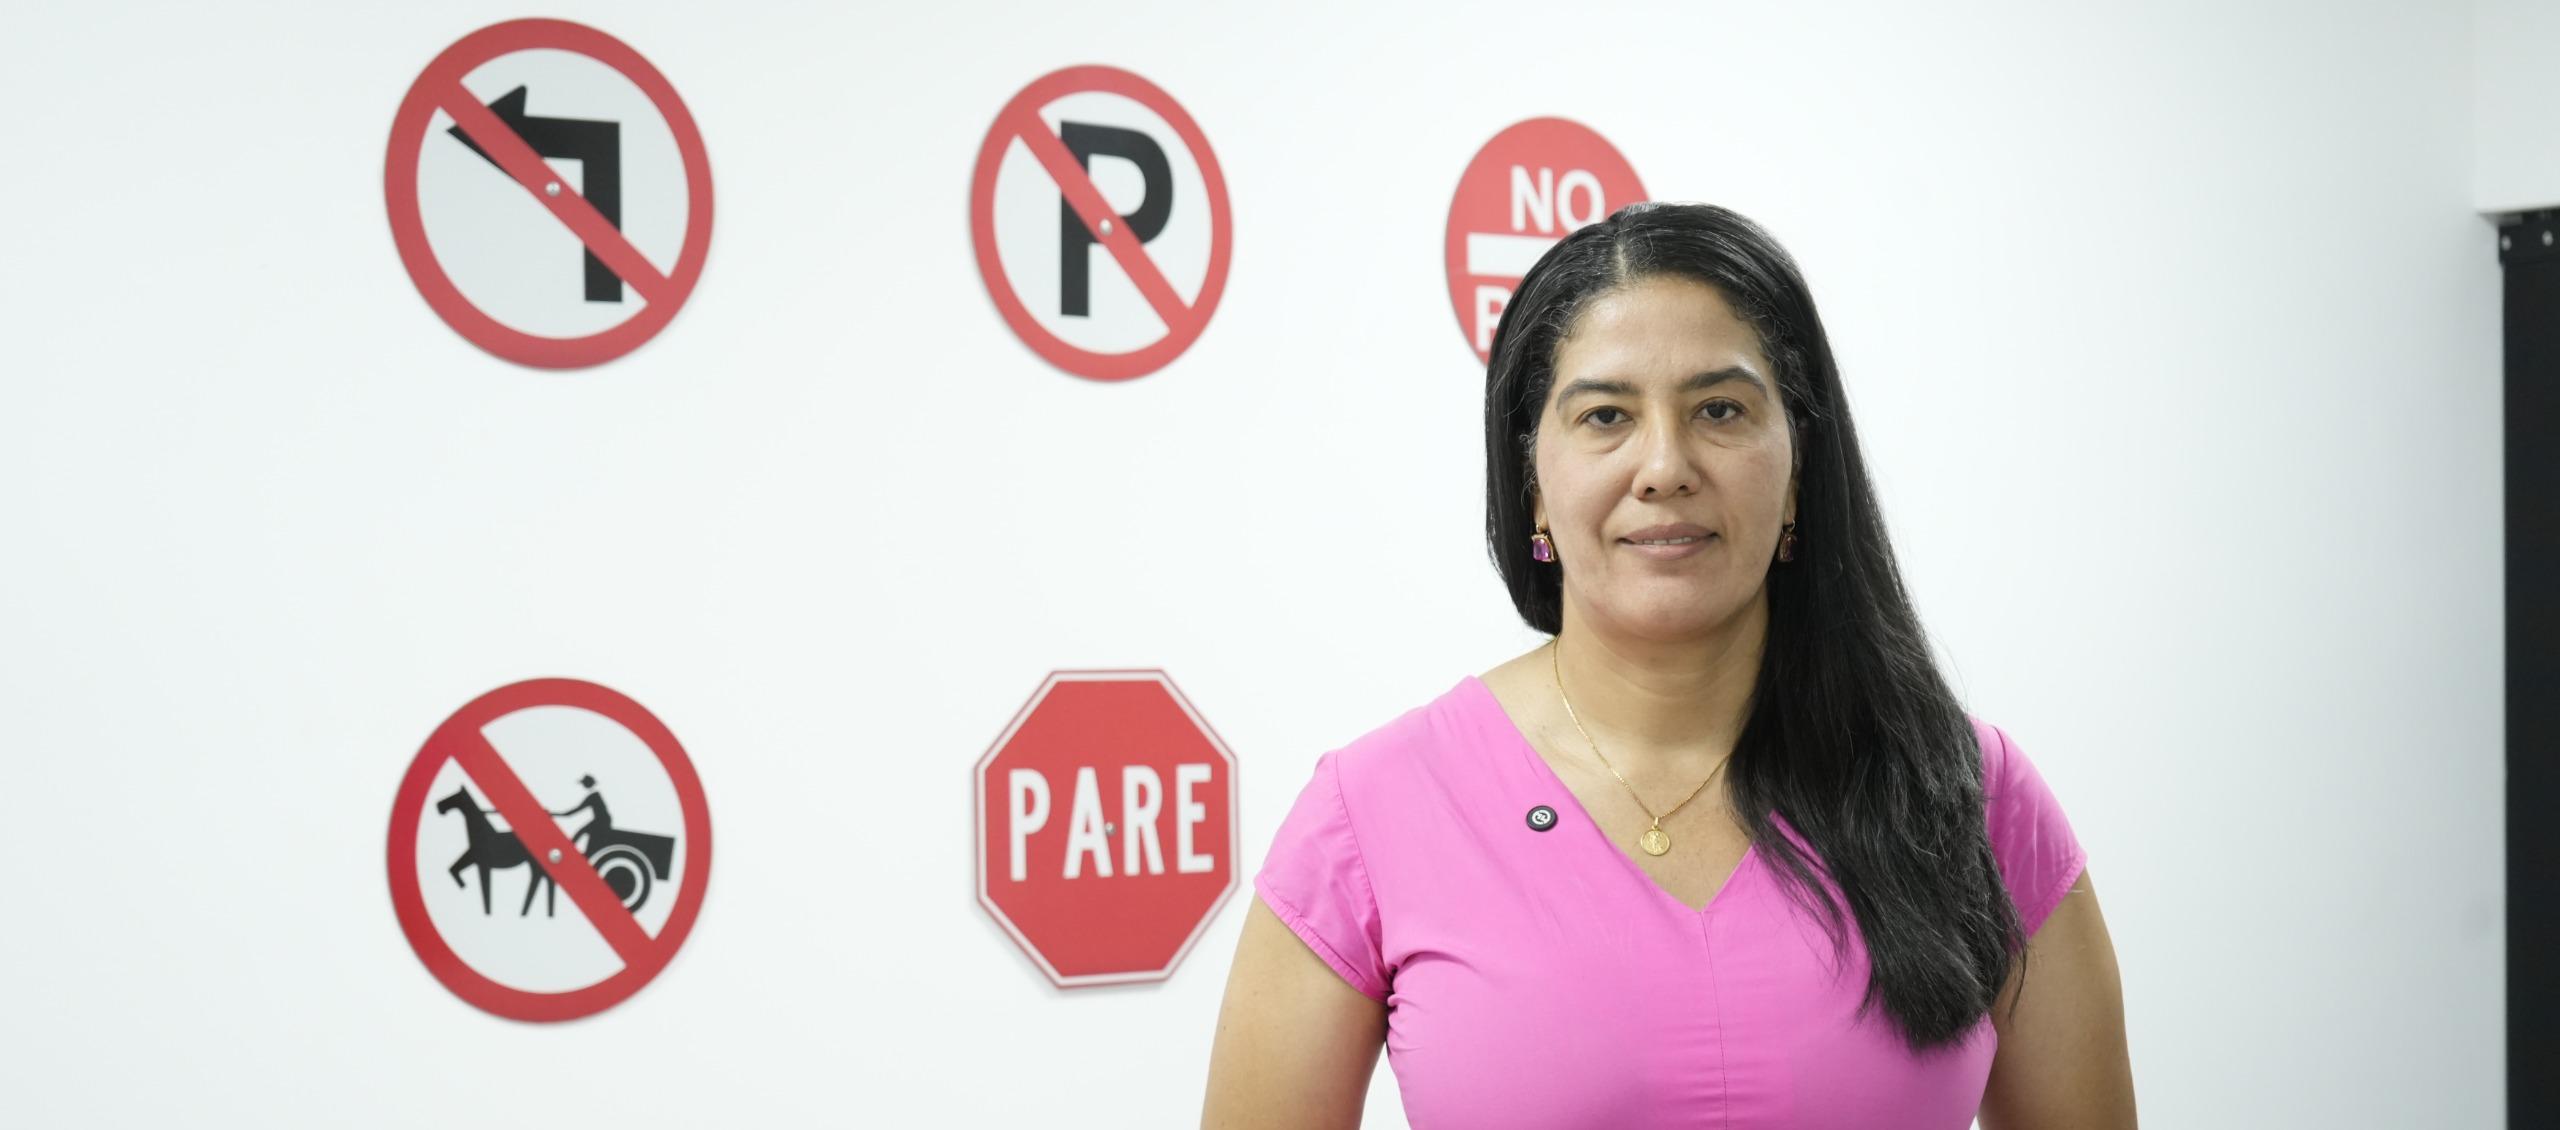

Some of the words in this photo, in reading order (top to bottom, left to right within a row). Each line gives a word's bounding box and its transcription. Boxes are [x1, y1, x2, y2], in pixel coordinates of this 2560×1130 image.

[1061, 120, 1173, 317] P
[1511, 165, 1605, 233] NO
[1009, 764, 1214, 881] PARE
